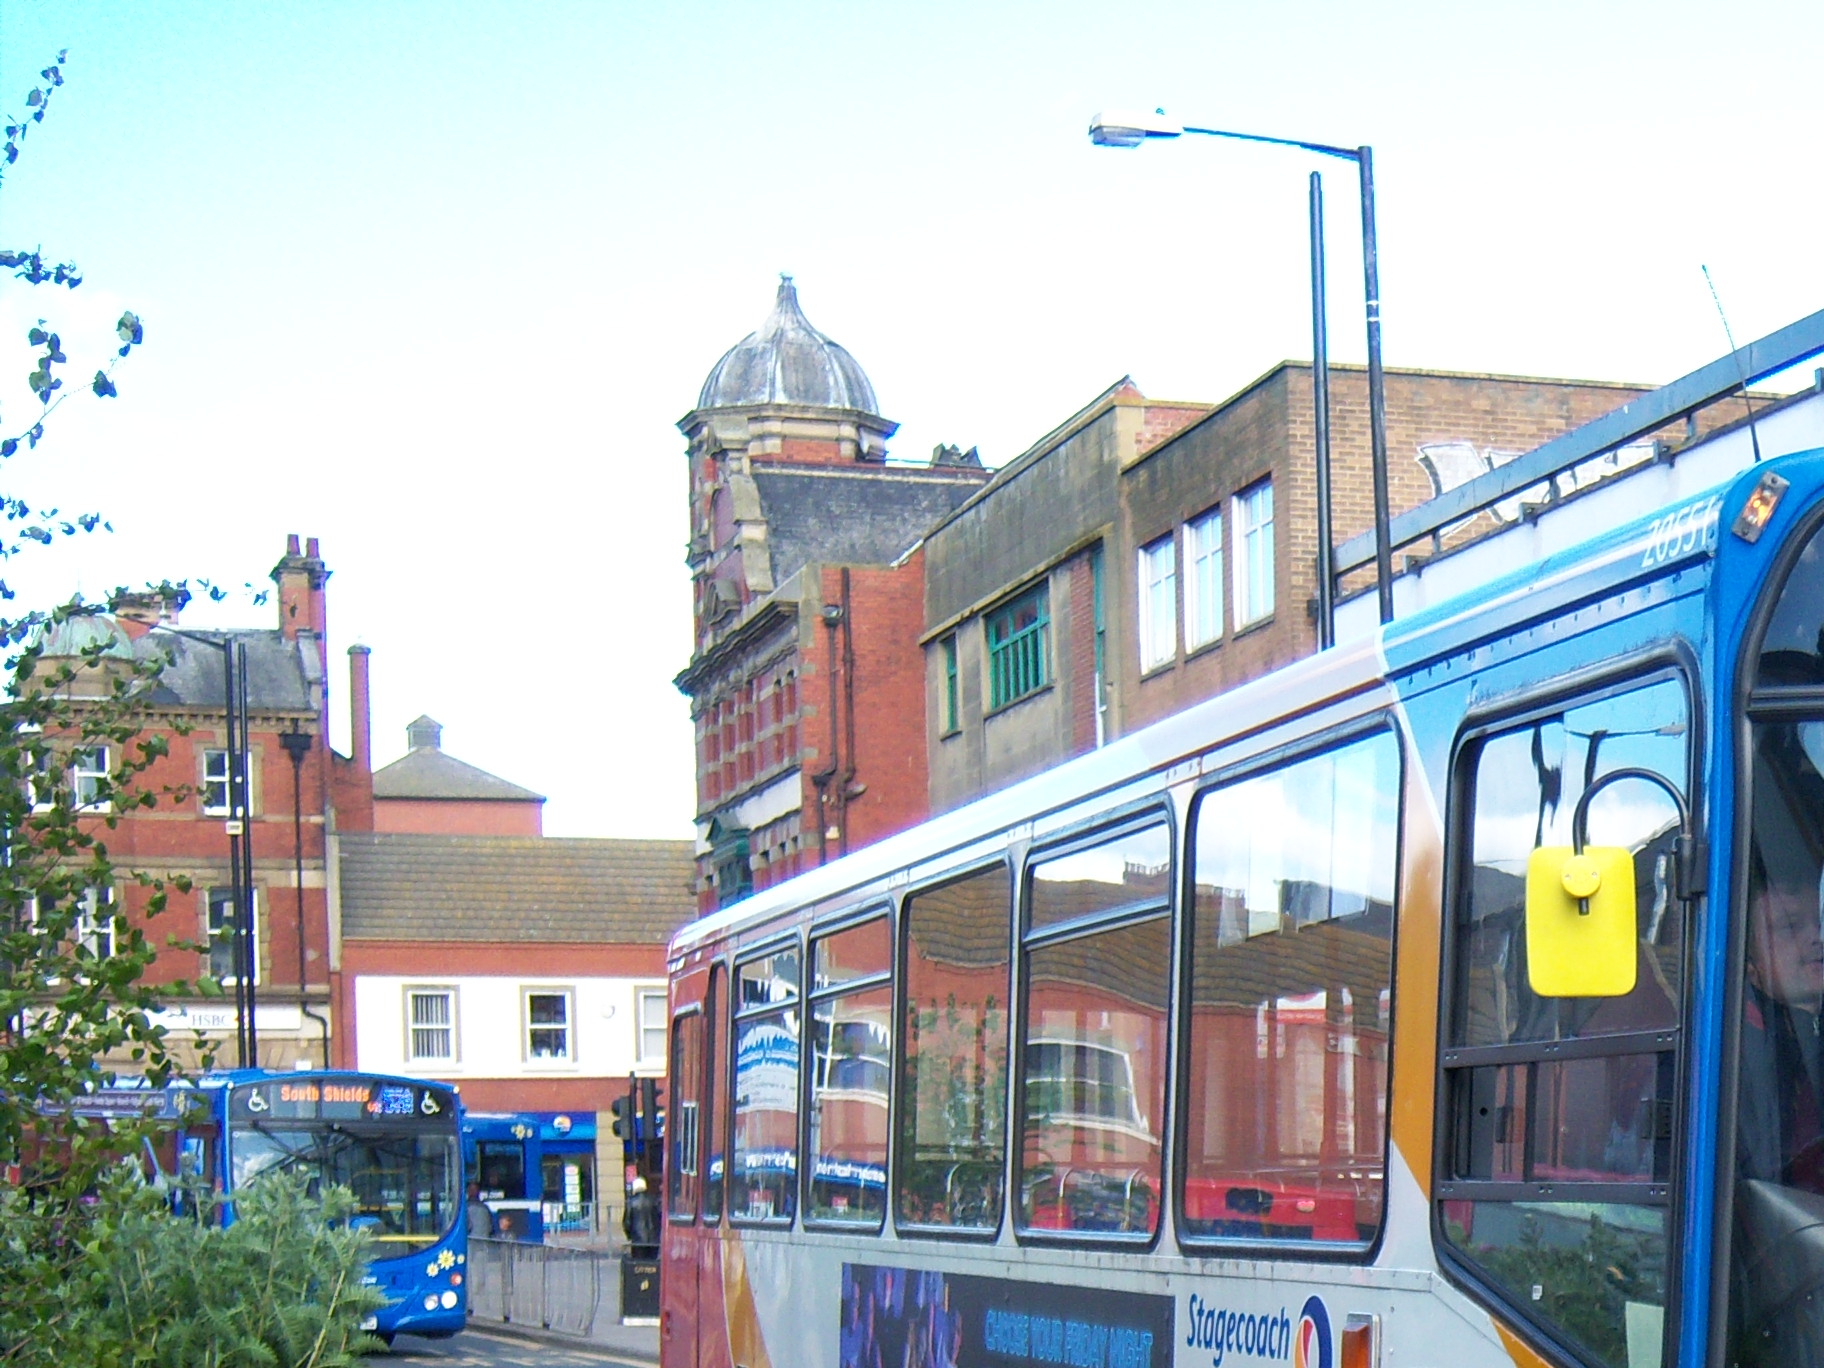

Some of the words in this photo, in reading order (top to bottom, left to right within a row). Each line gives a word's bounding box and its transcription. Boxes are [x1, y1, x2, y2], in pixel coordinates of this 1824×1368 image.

[1641, 495, 1716, 568] 20551
[191, 1014, 231, 1026] HSBC
[281, 1084, 320, 1102] South
[323, 1085, 371, 1103] Shields
[1187, 1293, 1290, 1368] Stagecoach
